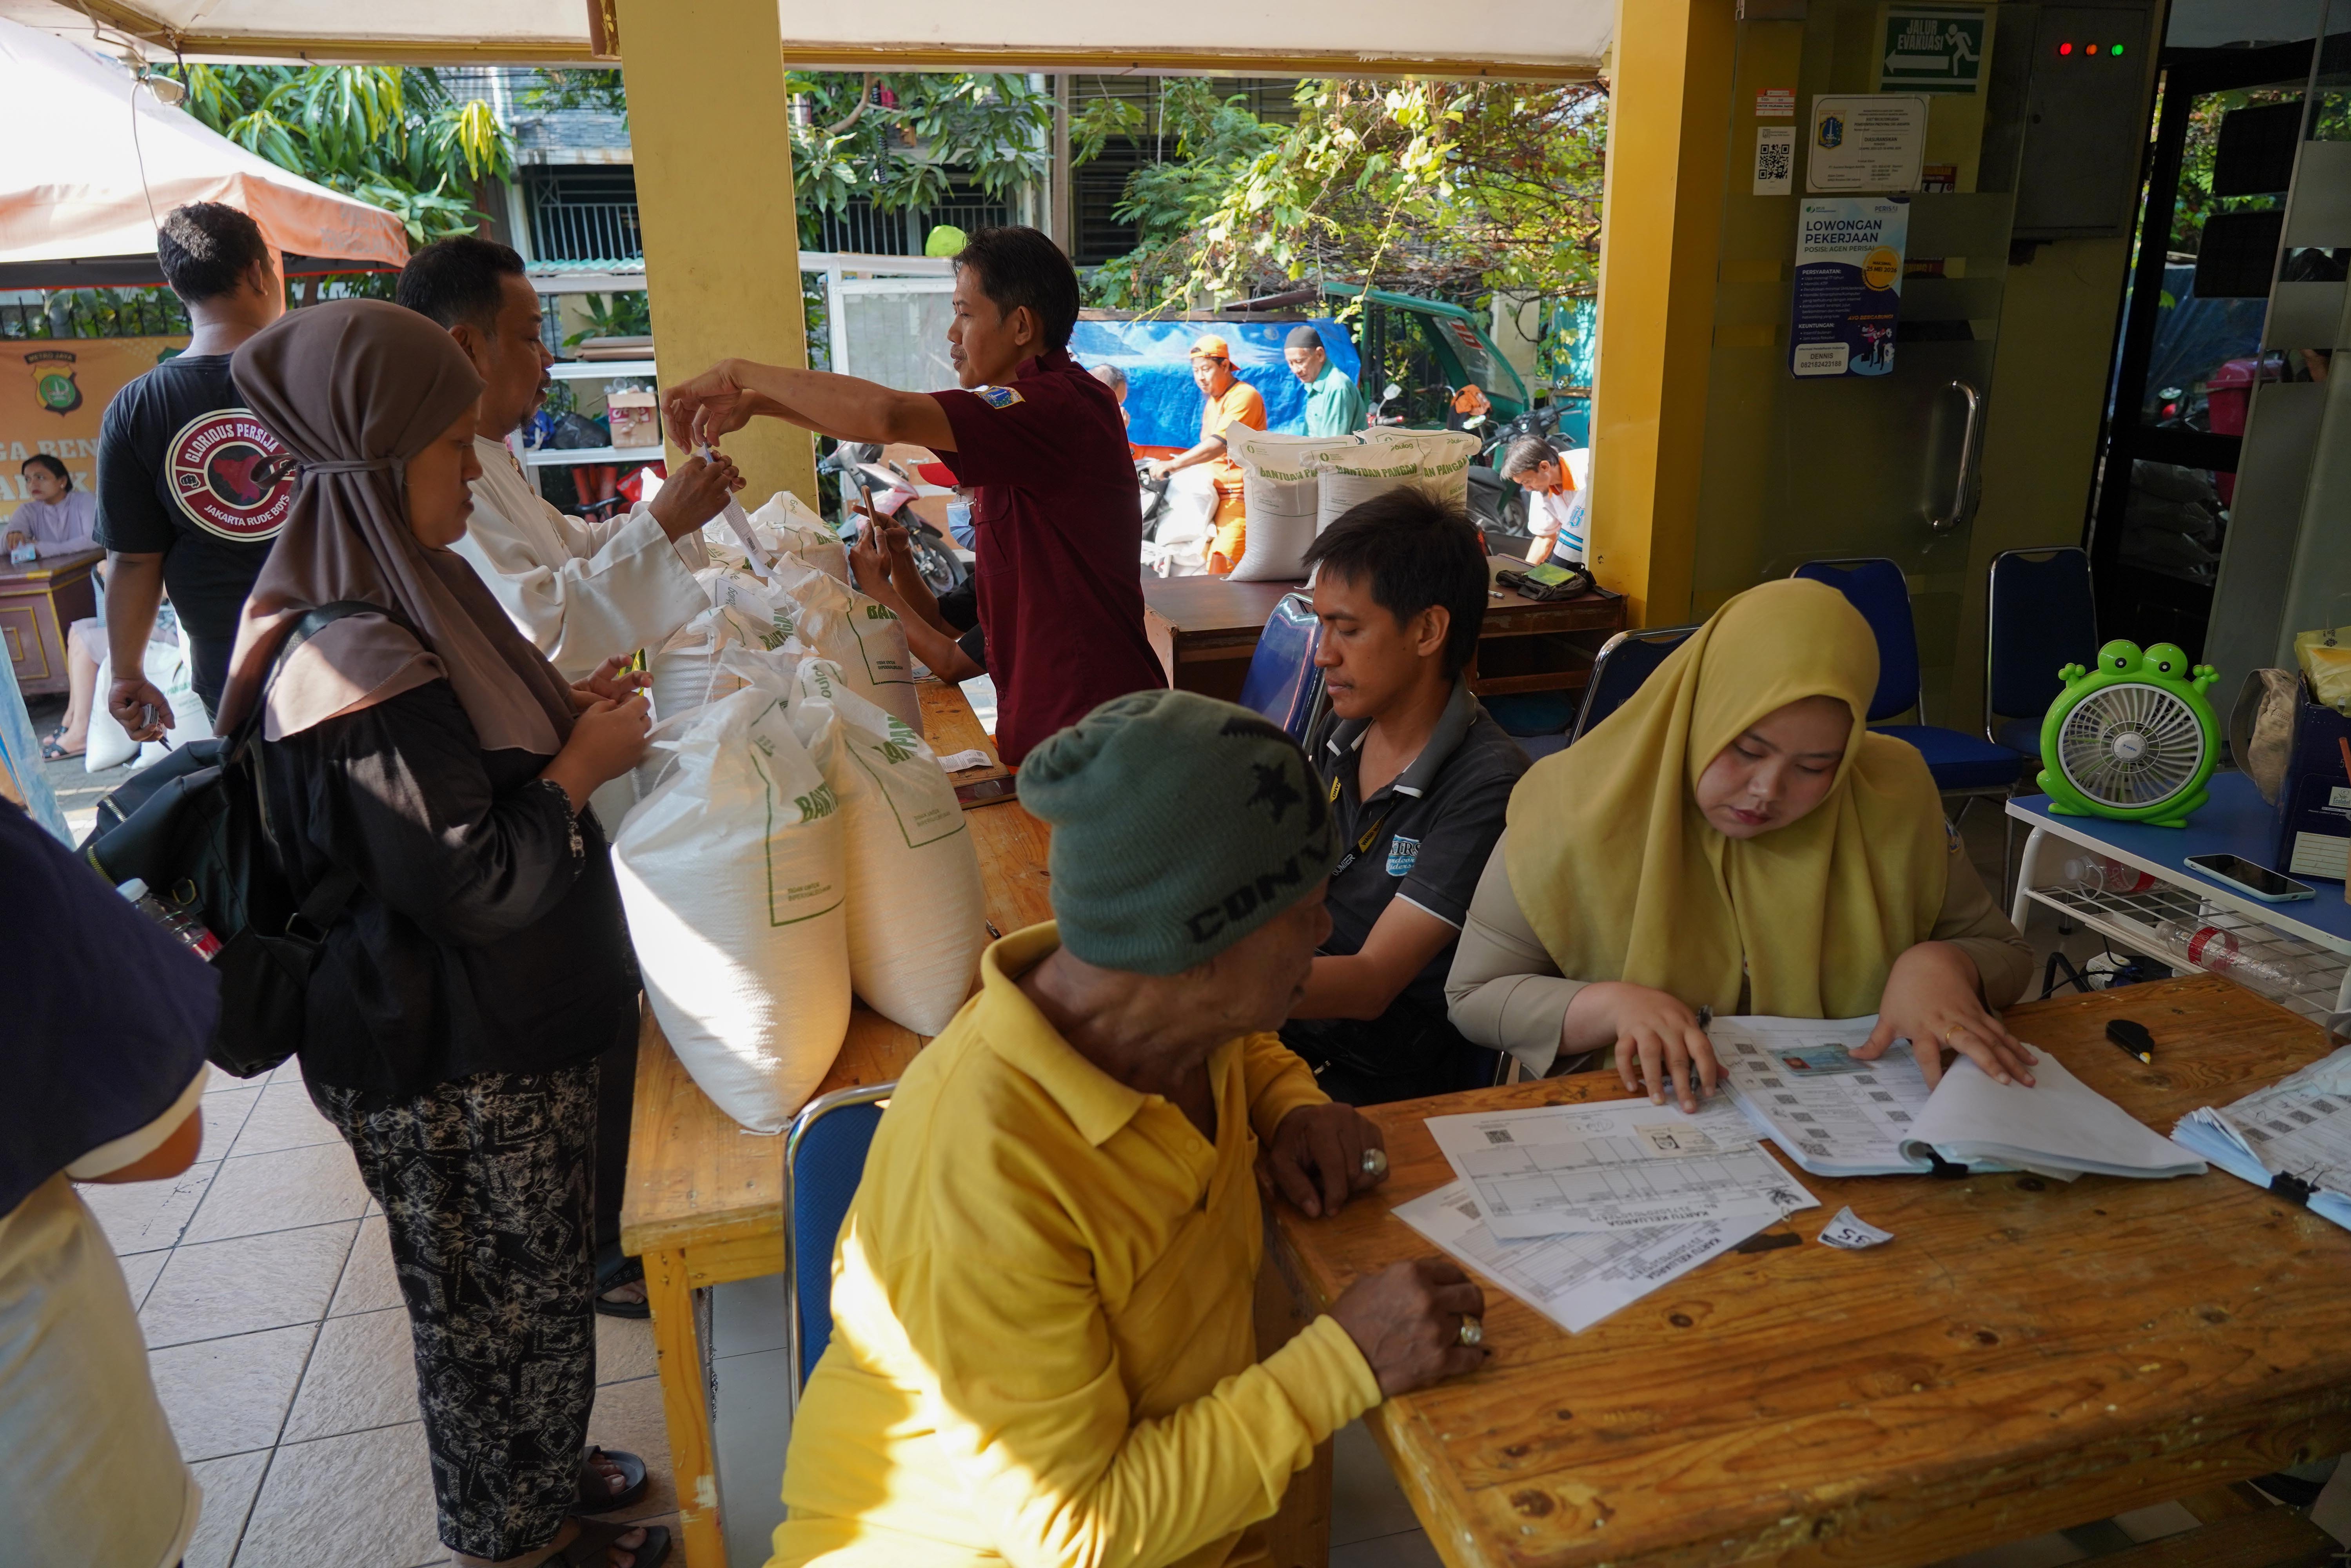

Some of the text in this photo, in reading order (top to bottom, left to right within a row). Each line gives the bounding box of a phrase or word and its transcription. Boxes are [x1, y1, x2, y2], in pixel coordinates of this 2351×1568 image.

[1906, 20, 1937, 35] JALUR
[1897, 34, 1944, 50] EVAKUASI
[1806, 220, 1882, 231] LOWONGAN
[1805, 232, 1878, 243] PEKERJAAN
[27, 352, 73, 361] METRO JAYA
[185, 424, 234, 463] GLORIOUS
[236, 423, 280, 453] PERSIJA
[1260, 466, 1303, 481] BANTUAN
[1336, 463, 1417, 478] BANTUAN PANGAN
[1437, 458, 1467, 475] PANGAN
[270, 494, 290, 516] BOYS
[204, 504, 246, 526] JAKARTA
[247, 512, 273, 526] RUDE
[1361, 832, 1374, 846] WASP
[1606, 1216, 1670, 1227] KELUARGA
[1671, 1211, 1709, 1221] KARTU
[1692, 1238, 1721, 1256] KARTU
[1647, 1254, 1692, 1280] KELUARGA
